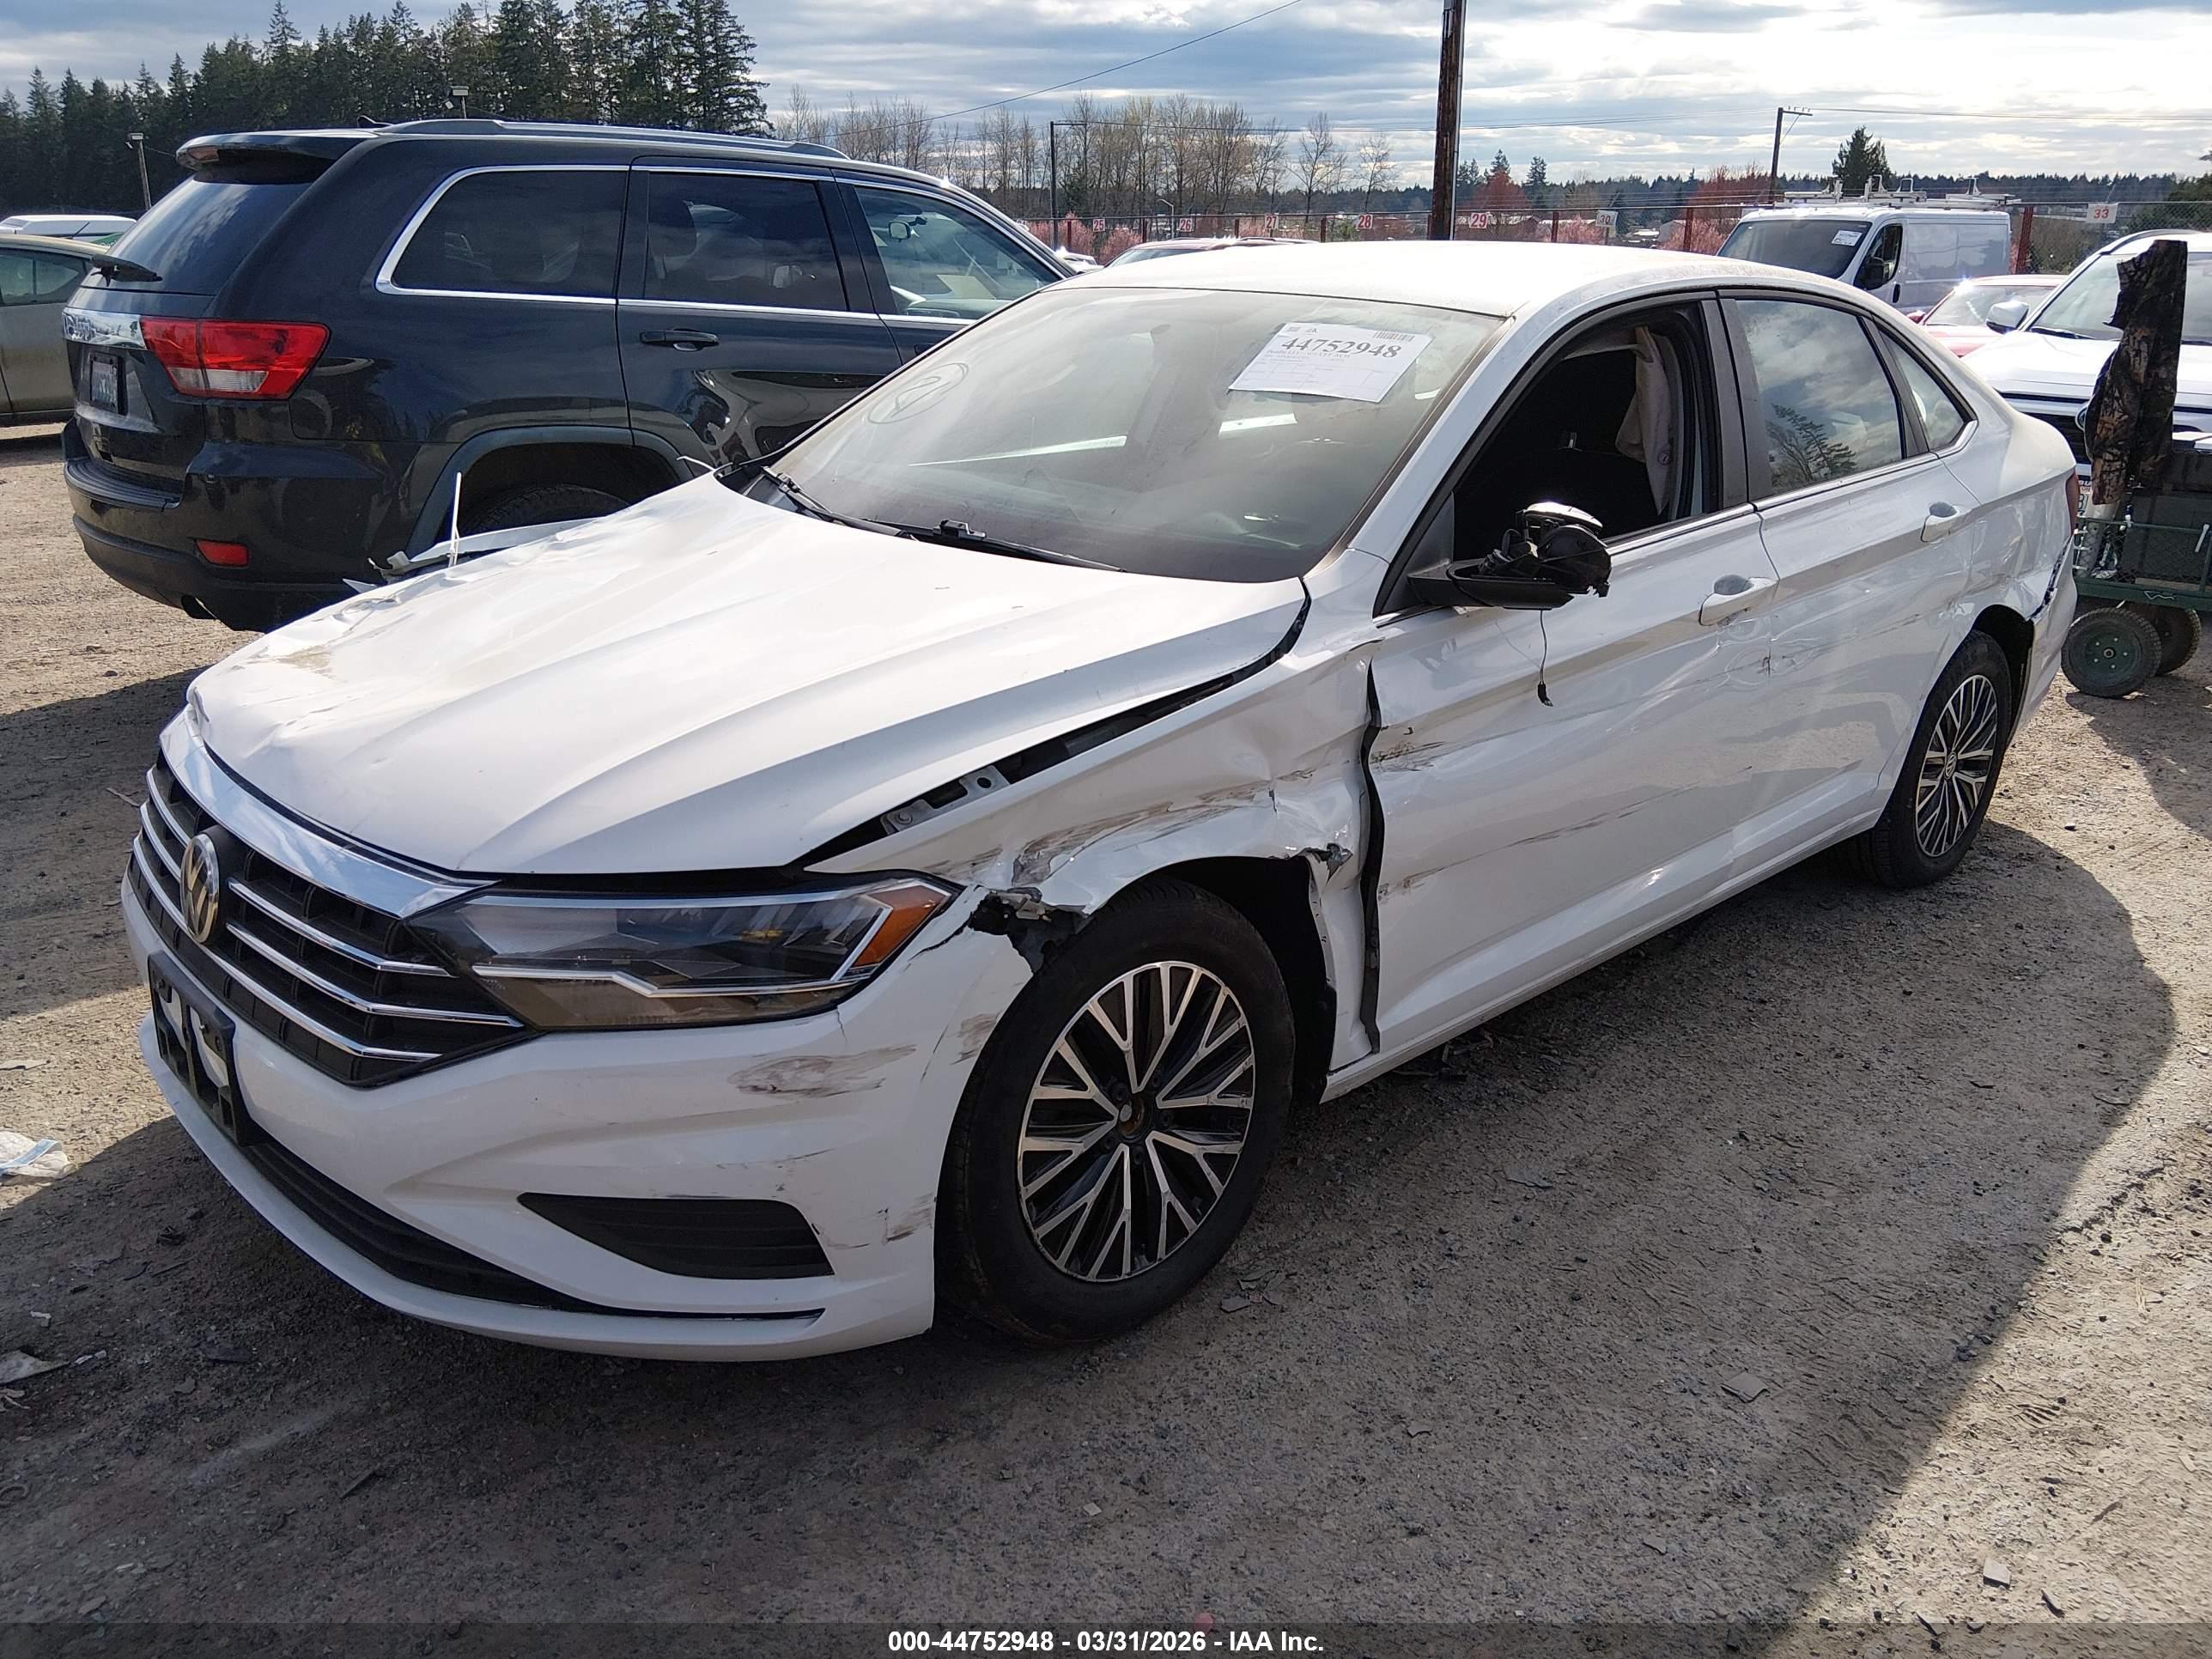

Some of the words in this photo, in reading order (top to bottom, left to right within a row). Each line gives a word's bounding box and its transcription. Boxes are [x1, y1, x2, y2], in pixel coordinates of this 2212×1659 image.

[1599, 215, 1611, 224] 30
[2094, 209, 2109, 219] 33
[1094, 219, 1104, 231] 25
[1180, 219, 1192, 231] 26
[1266, 216, 1278, 229] 27
[1358, 215, 1371, 228] 28
[1470, 214, 1486, 228] 29
[1281, 337, 1402, 358] 44752948
